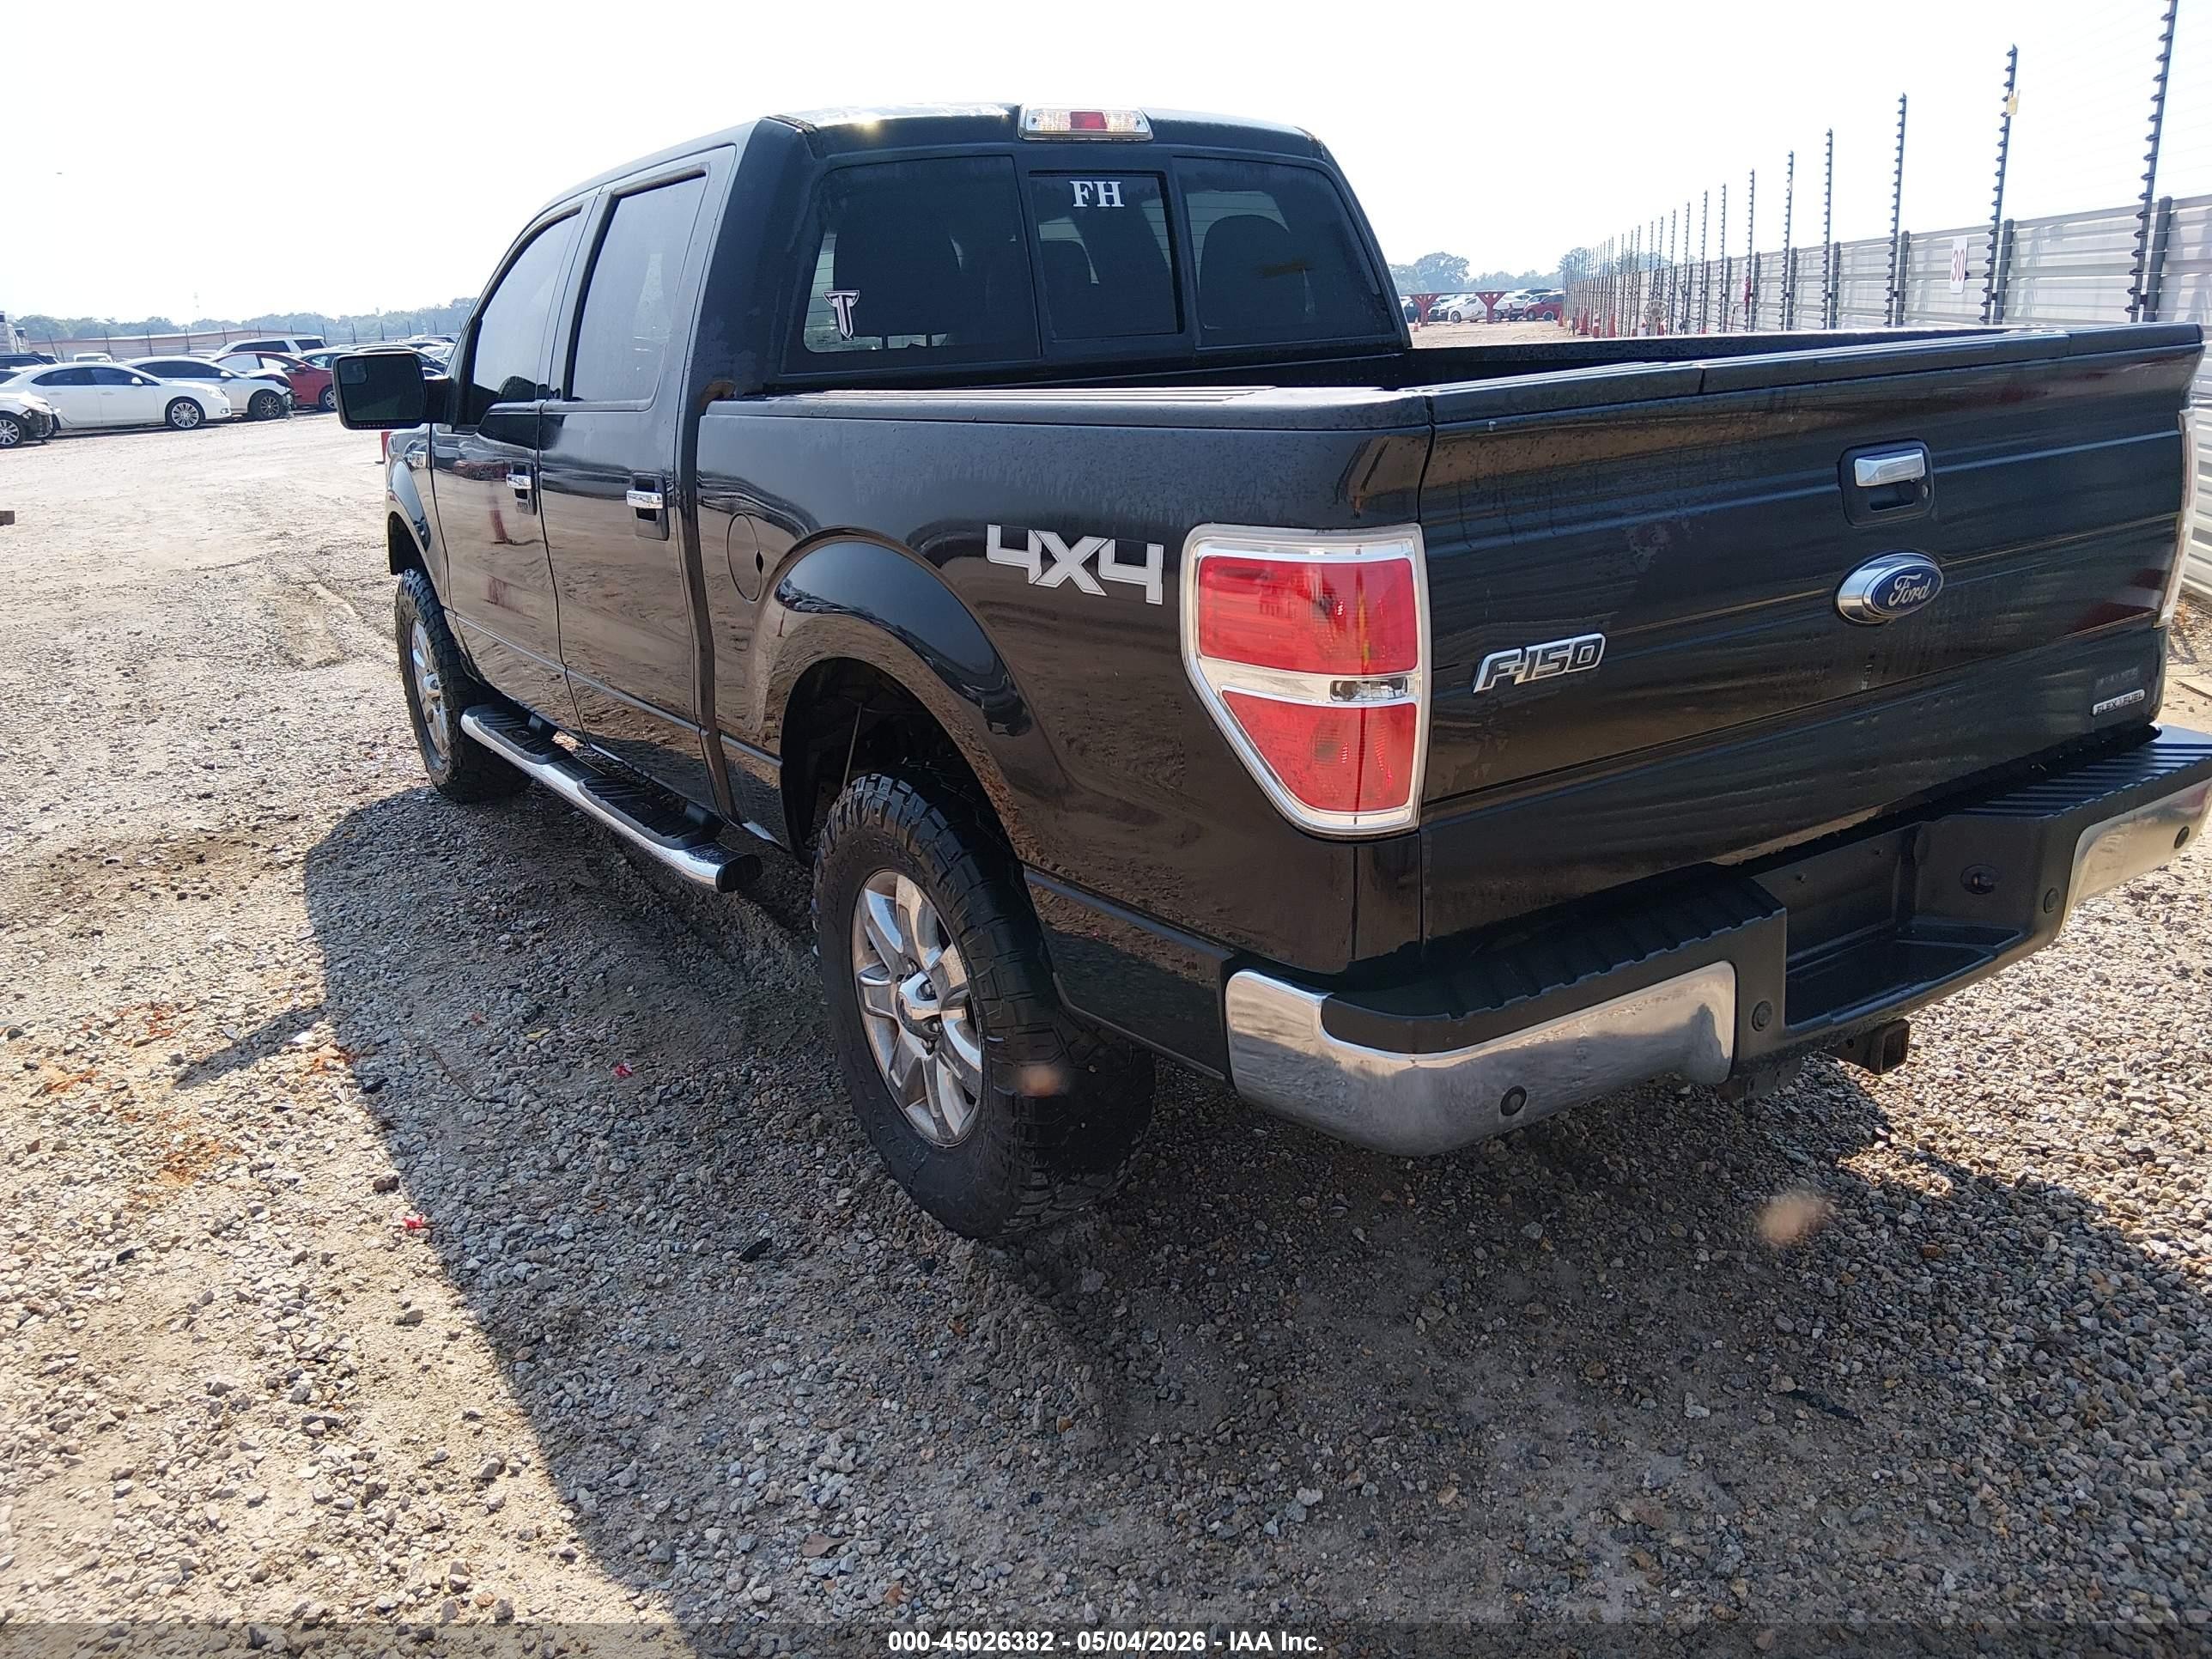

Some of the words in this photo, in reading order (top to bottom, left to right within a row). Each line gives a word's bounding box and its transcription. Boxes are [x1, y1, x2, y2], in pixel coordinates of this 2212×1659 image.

[1069, 180, 1125, 207] FH
[1952, 249, 1965, 282] 30
[1887, 573, 1932, 606] Ford
[1473, 633, 1606, 694] F-150
